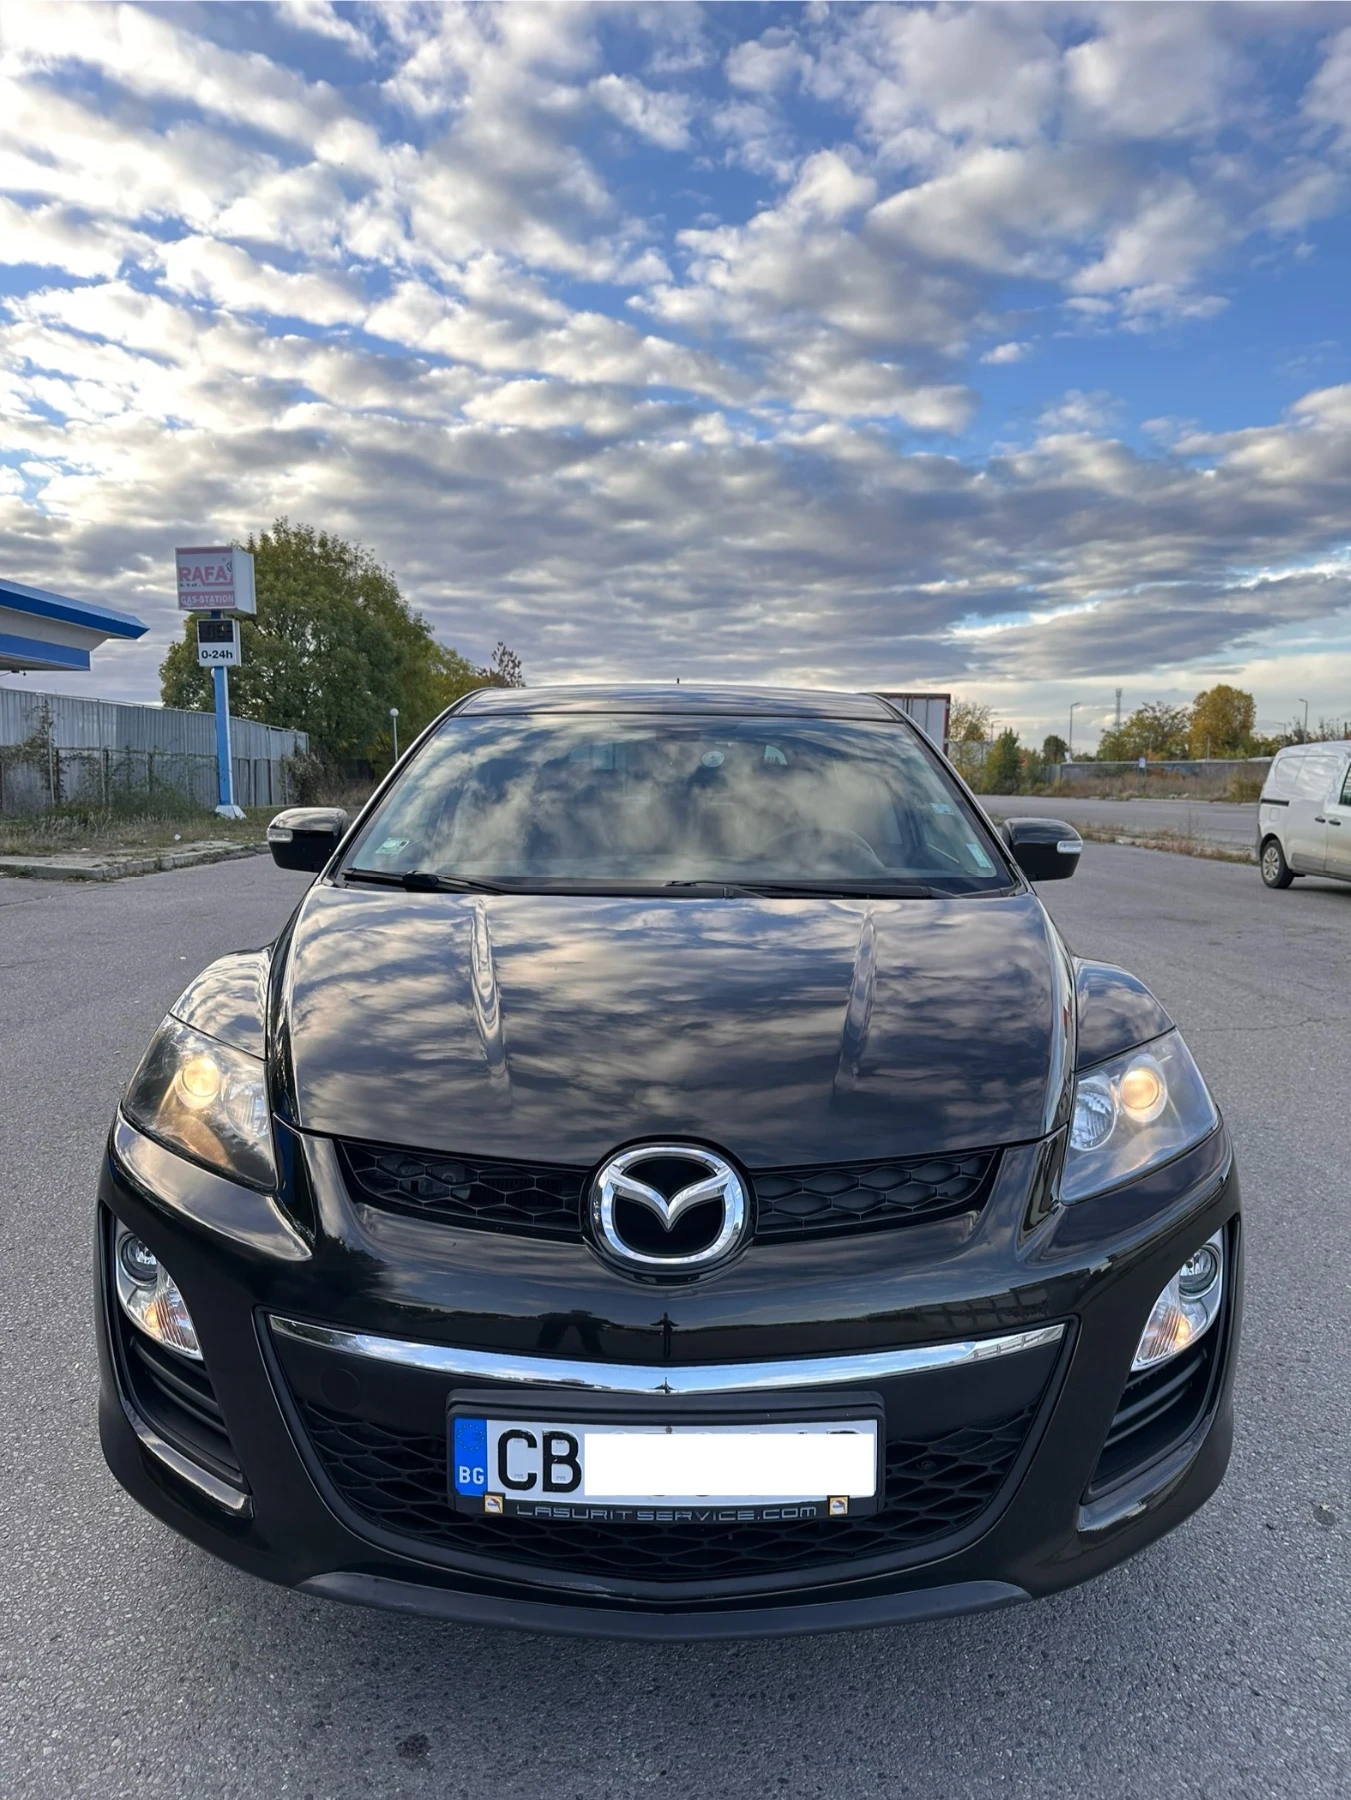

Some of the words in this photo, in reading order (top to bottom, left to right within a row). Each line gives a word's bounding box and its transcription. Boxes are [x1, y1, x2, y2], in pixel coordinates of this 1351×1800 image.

[179, 566, 228, 582] RAFA
[181, 594, 234, 604] GAS-STATION
[201, 649, 233, 659] 0-24h
[498, 1428, 582, 1493] CB
[459, 1466, 485, 1485] BG
